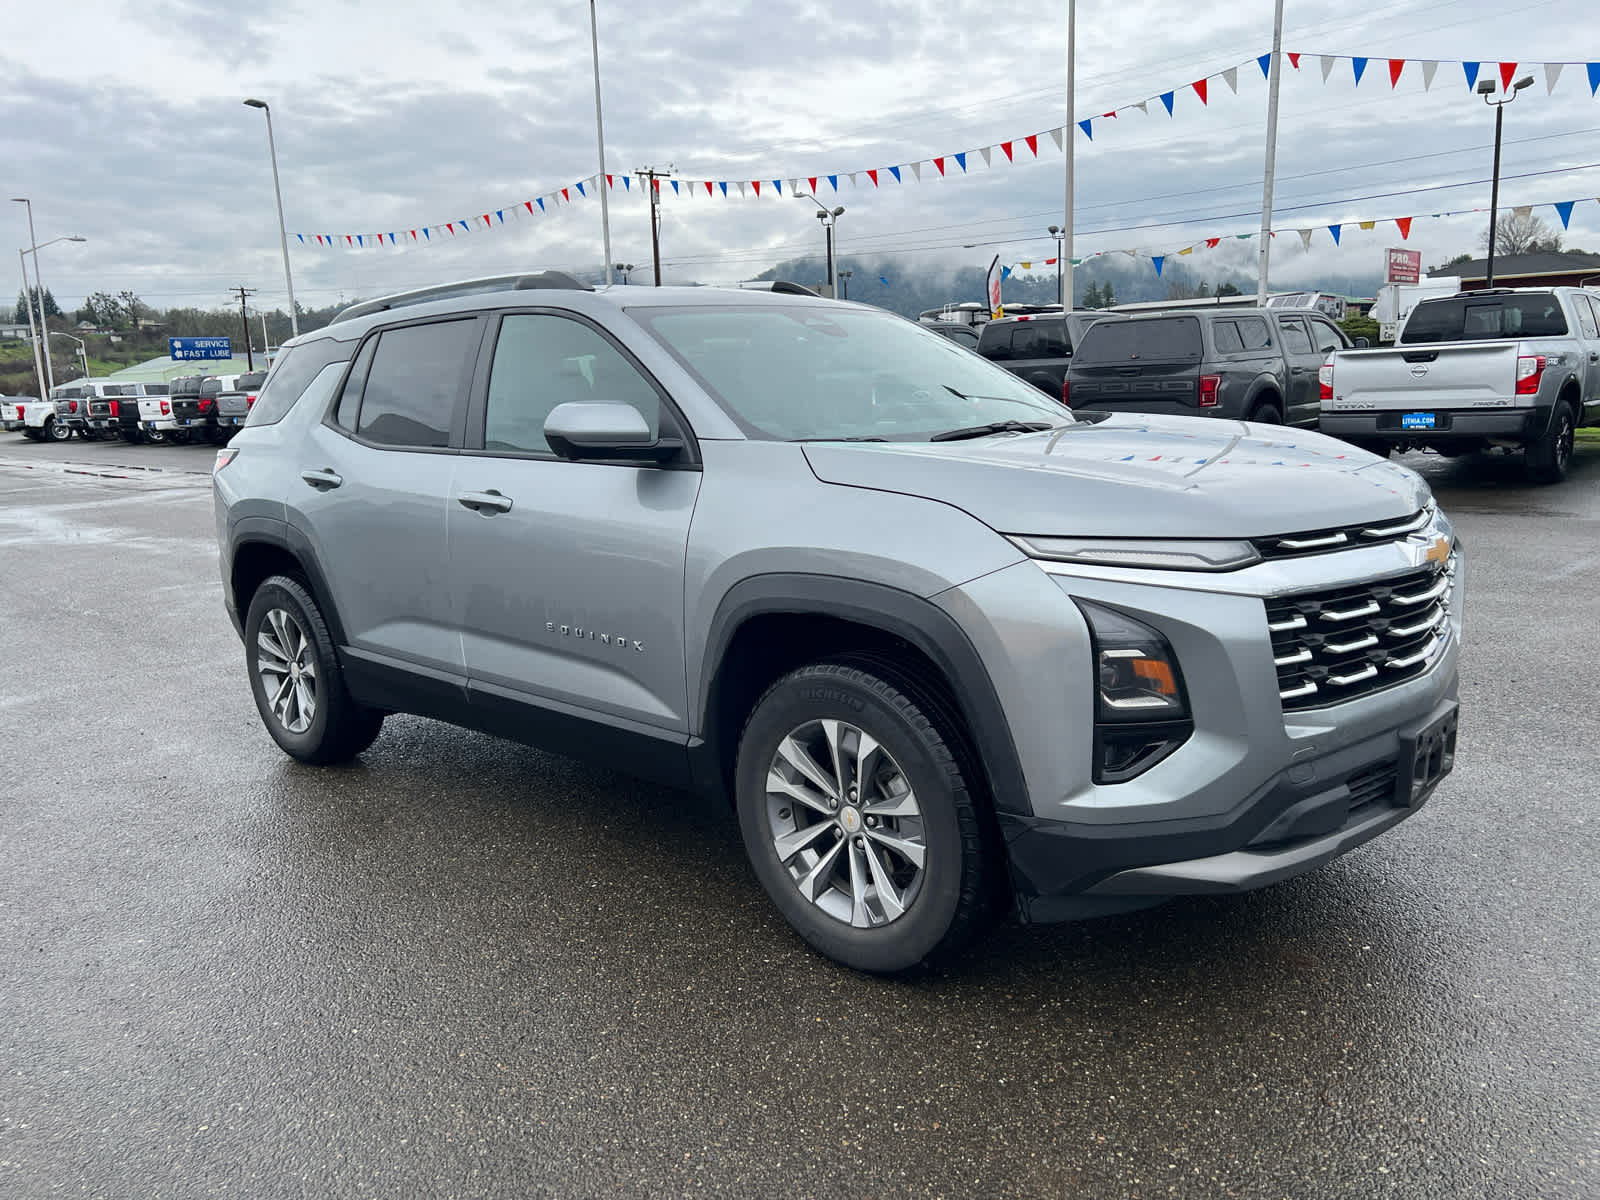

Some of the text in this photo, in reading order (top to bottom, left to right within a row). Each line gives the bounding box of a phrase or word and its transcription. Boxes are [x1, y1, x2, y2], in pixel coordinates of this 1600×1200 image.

[194, 340, 229, 348] SERVICE
[183, 349, 231, 358] FAST LUBE
[1072, 381, 1194, 393] FORD
[1402, 416, 1435, 425] LITHIA.COM
[545, 621, 644, 652] EQUINOX
